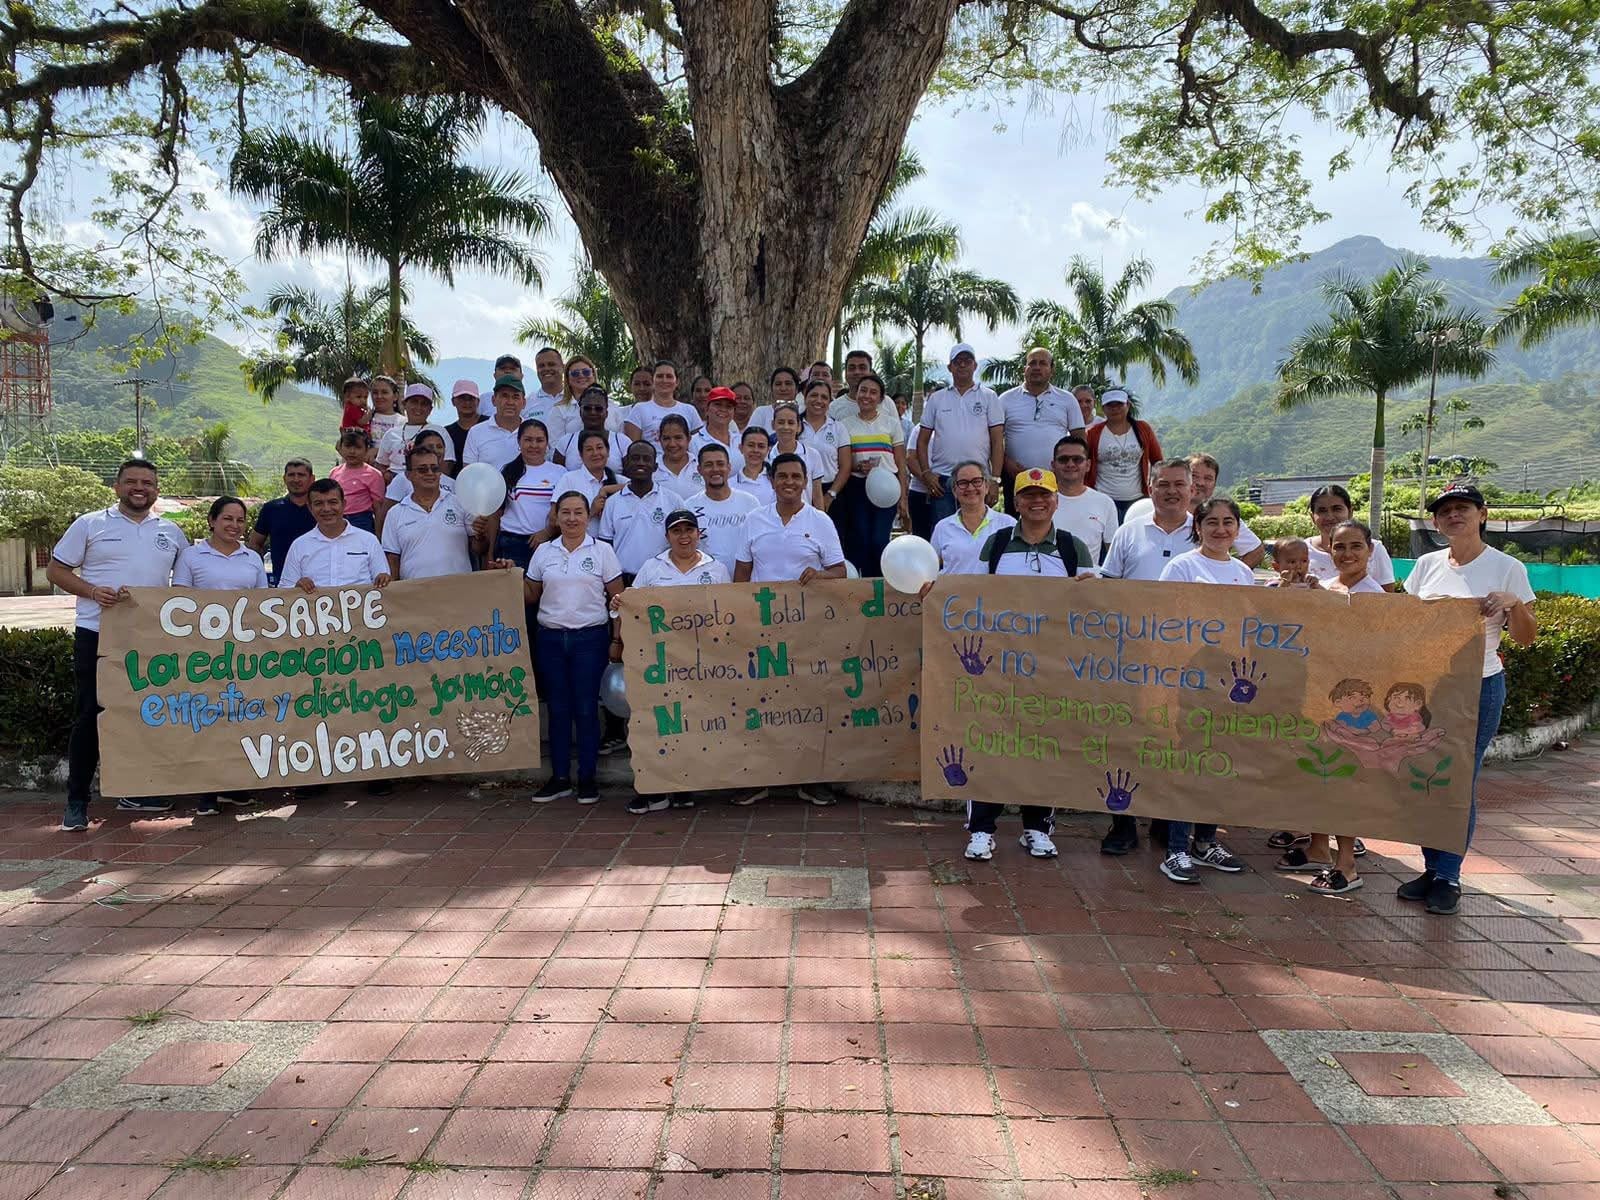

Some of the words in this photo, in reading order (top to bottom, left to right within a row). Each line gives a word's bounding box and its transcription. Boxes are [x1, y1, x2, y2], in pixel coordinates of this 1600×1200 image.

[159, 589, 388, 642] COLSARPE
[647, 600, 736, 643] Respeto
[824, 605, 835, 620] a
[942, 593, 1049, 636] Educar
[1067, 608, 1226, 656] requiere
[1240, 616, 1310, 657] Paz,
[125, 650, 181, 692] La
[186, 635, 385, 683] educación
[392, 608, 522, 666] necesita
[809, 658, 829, 676] un
[841, 639, 899, 698] golpe
[1000, 649, 1038, 677] no
[272, 692, 292, 723] y
[429, 666, 526, 716] jamás
[653, 701, 689, 737] Ni
[700, 716, 727, 733] una
[745, 706, 824, 731] amenaza
[954, 676, 1133, 727] Protejamos
[1146, 704, 1169, 729] a
[1186, 706, 1321, 749] quienes
[1082, 732, 1110, 766] el
